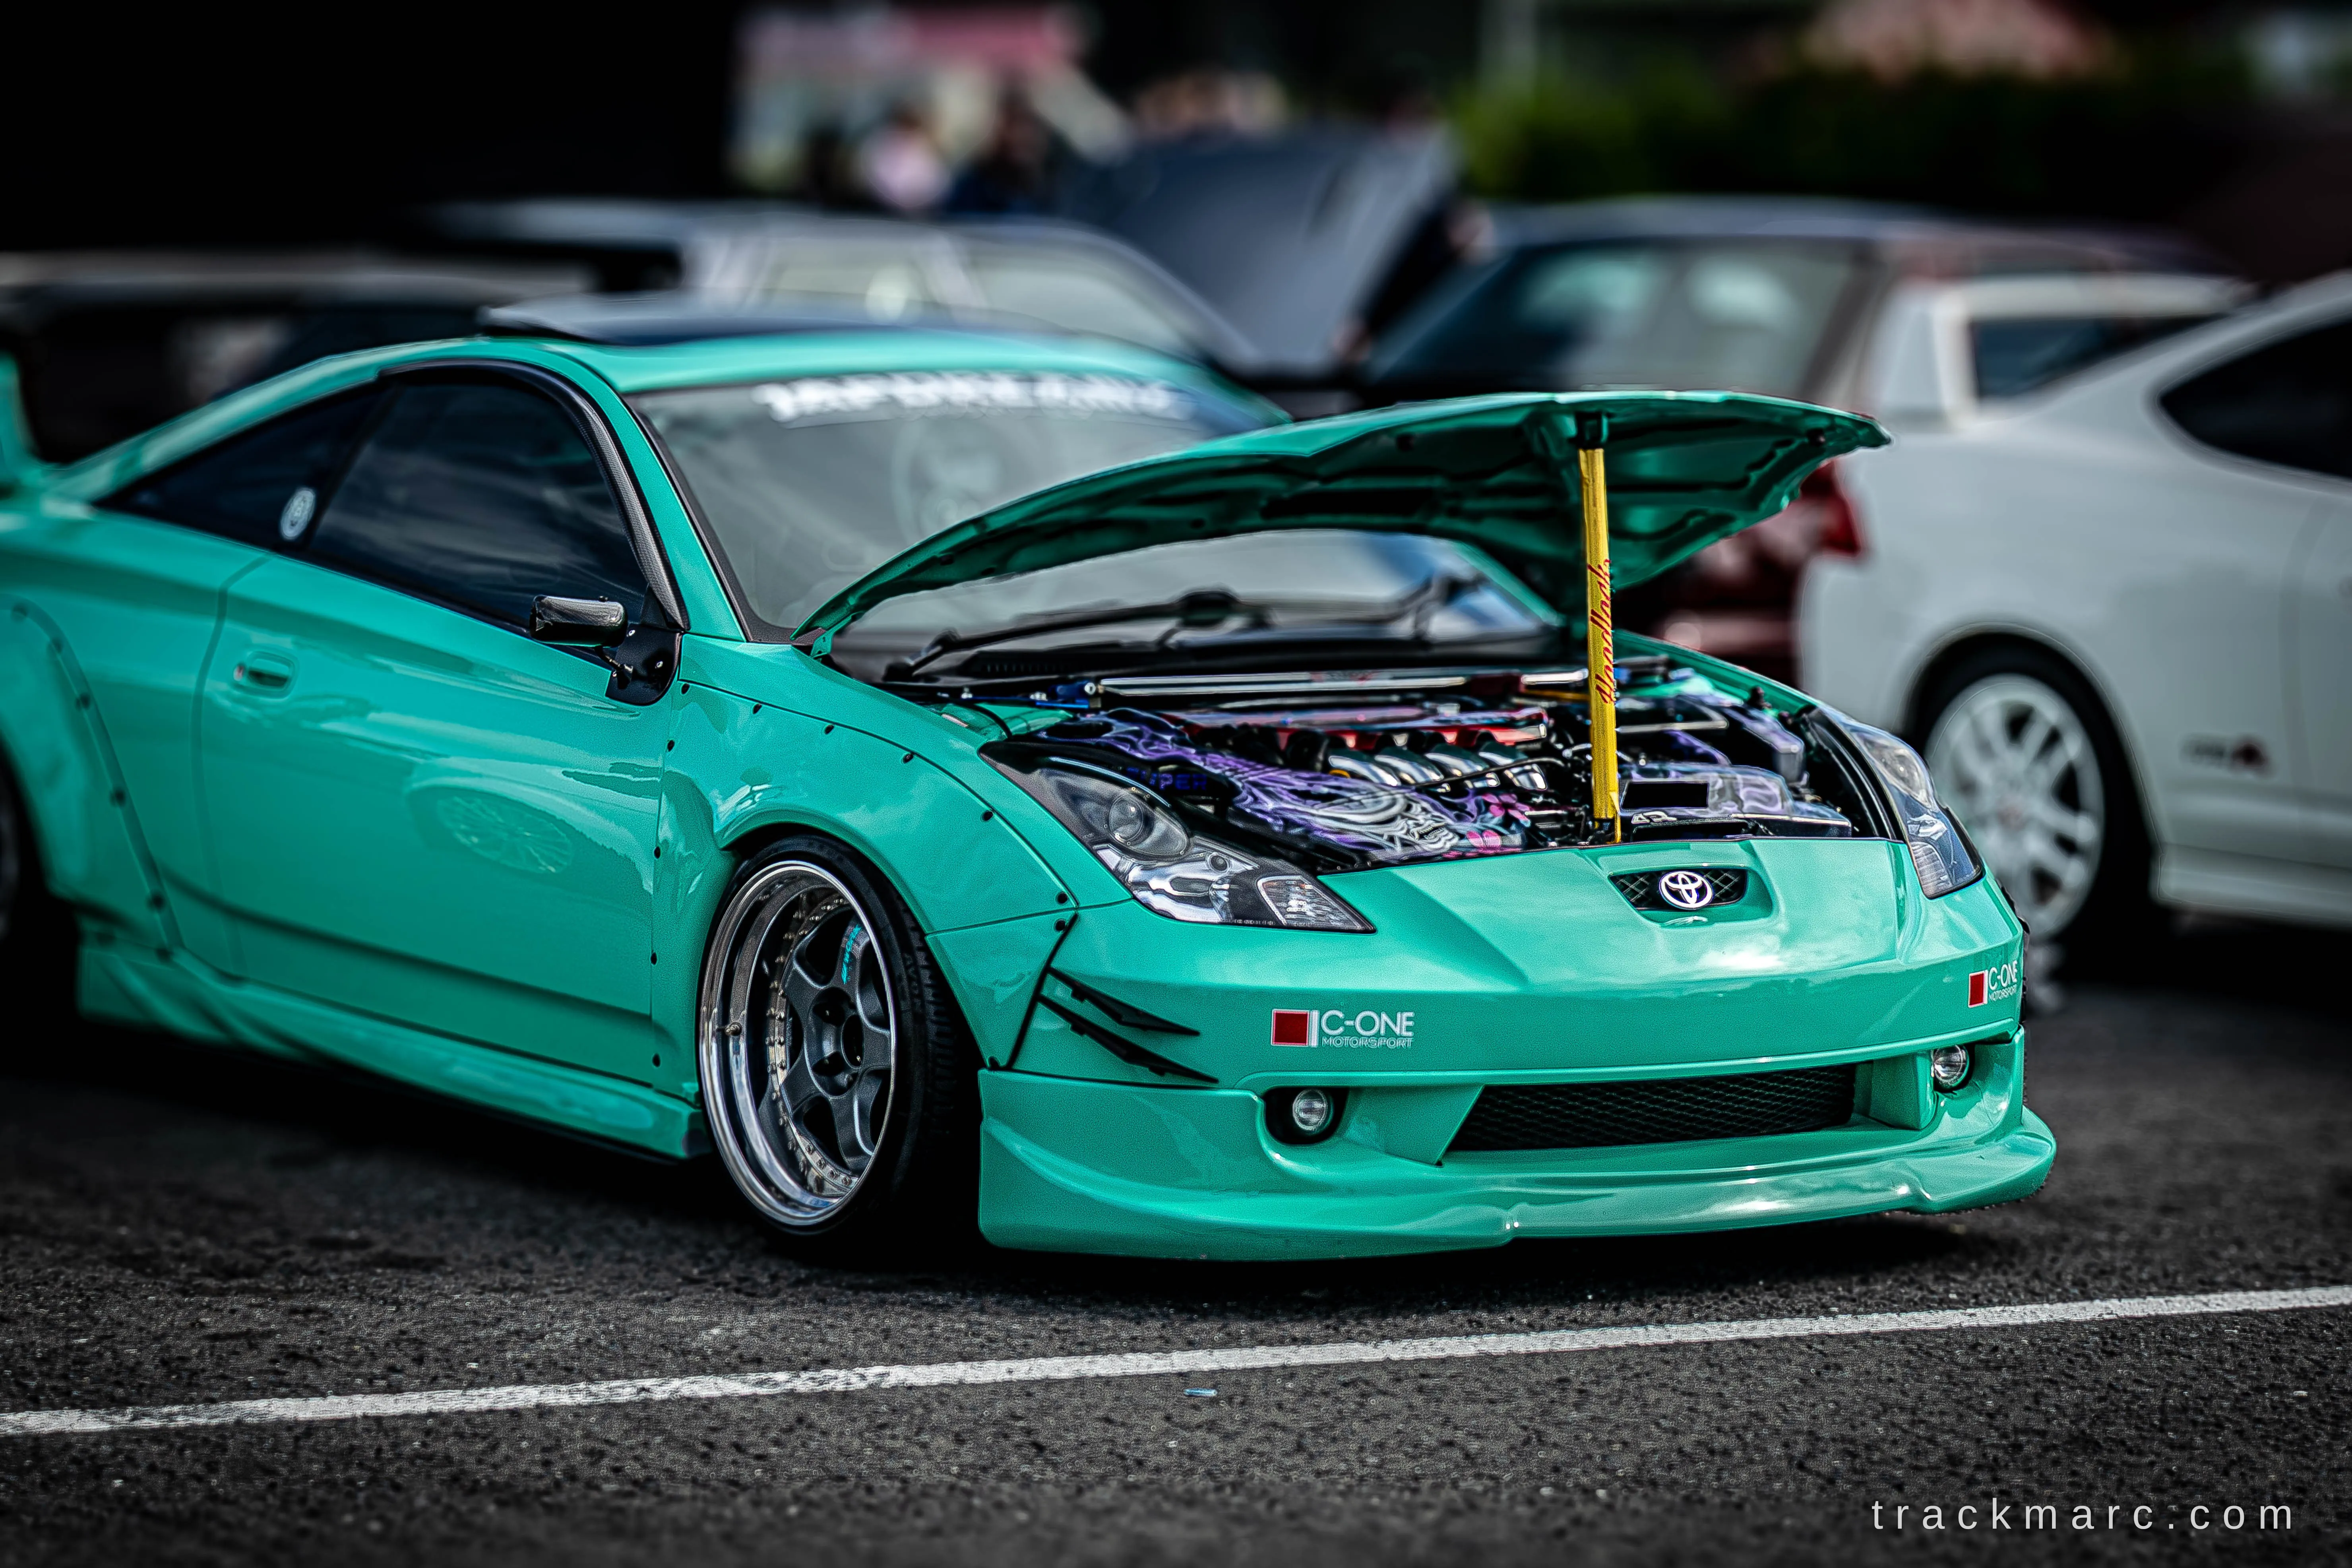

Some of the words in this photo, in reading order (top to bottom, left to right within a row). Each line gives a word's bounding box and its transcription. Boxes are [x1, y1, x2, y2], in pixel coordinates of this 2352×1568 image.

[1988, 960, 2018, 990] C-ONE
[1988, 984, 2018, 1001] MOTORSPORT
[1320, 1010, 1415, 1037] C-ONE
[1322, 1036, 1414, 1049] MOTORSPORT
